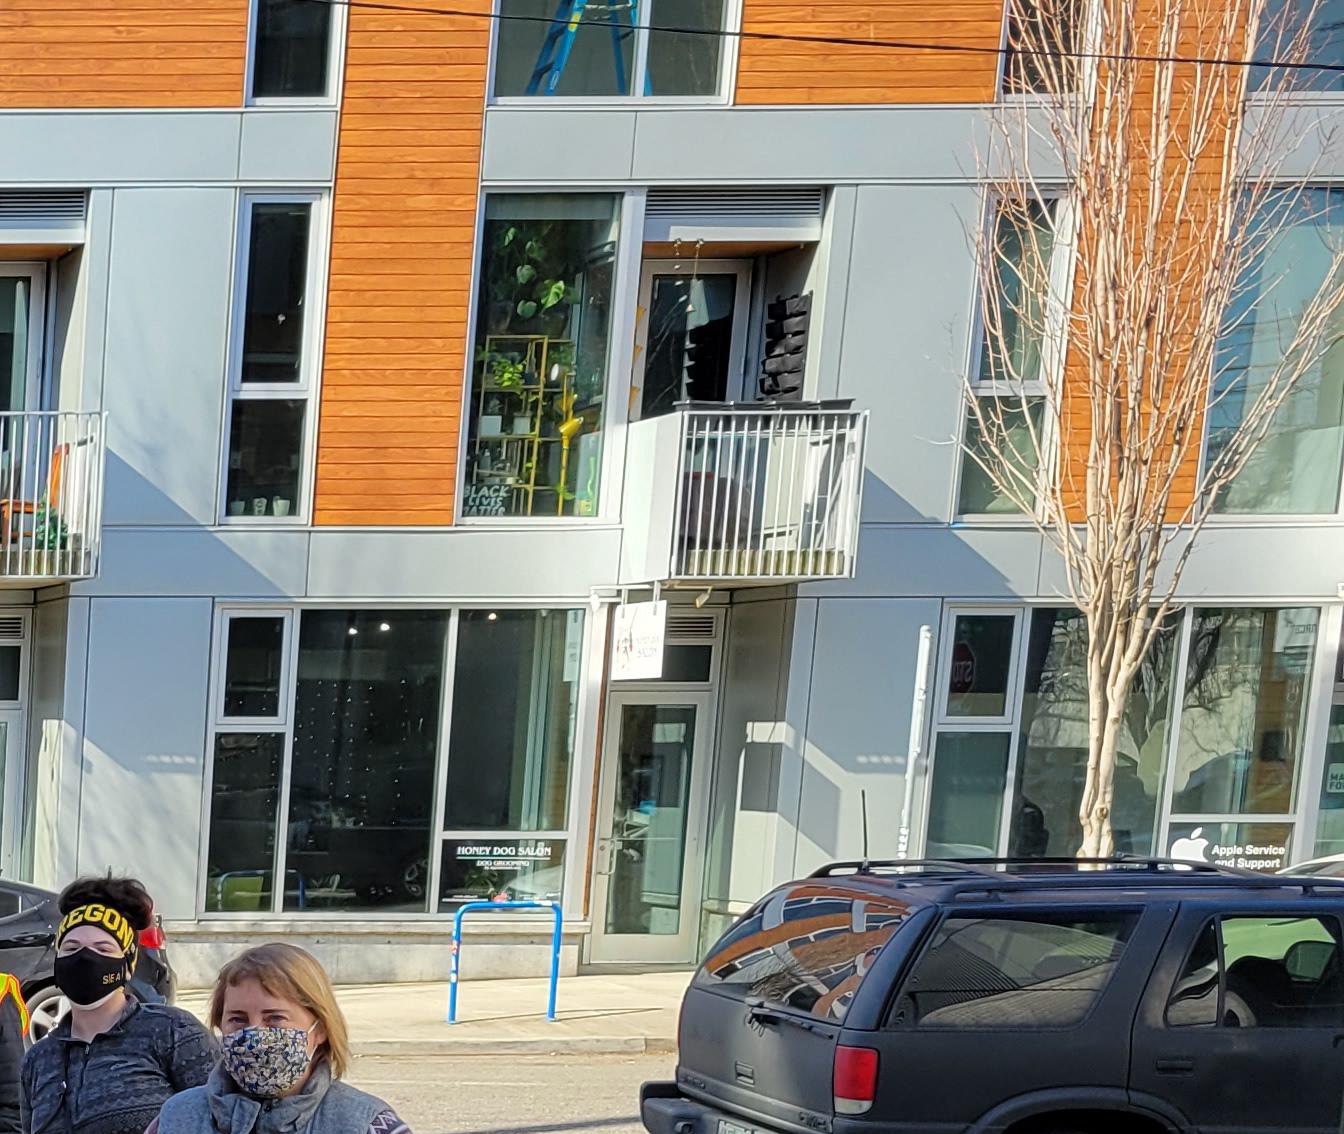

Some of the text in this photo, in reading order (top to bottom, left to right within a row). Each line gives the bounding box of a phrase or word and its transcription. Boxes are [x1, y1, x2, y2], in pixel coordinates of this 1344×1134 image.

[456, 846, 552, 857] HONEY DOG SALON
[1211, 844, 1286, 857] Apple Service
[1236, 858, 1281, 870] Support
